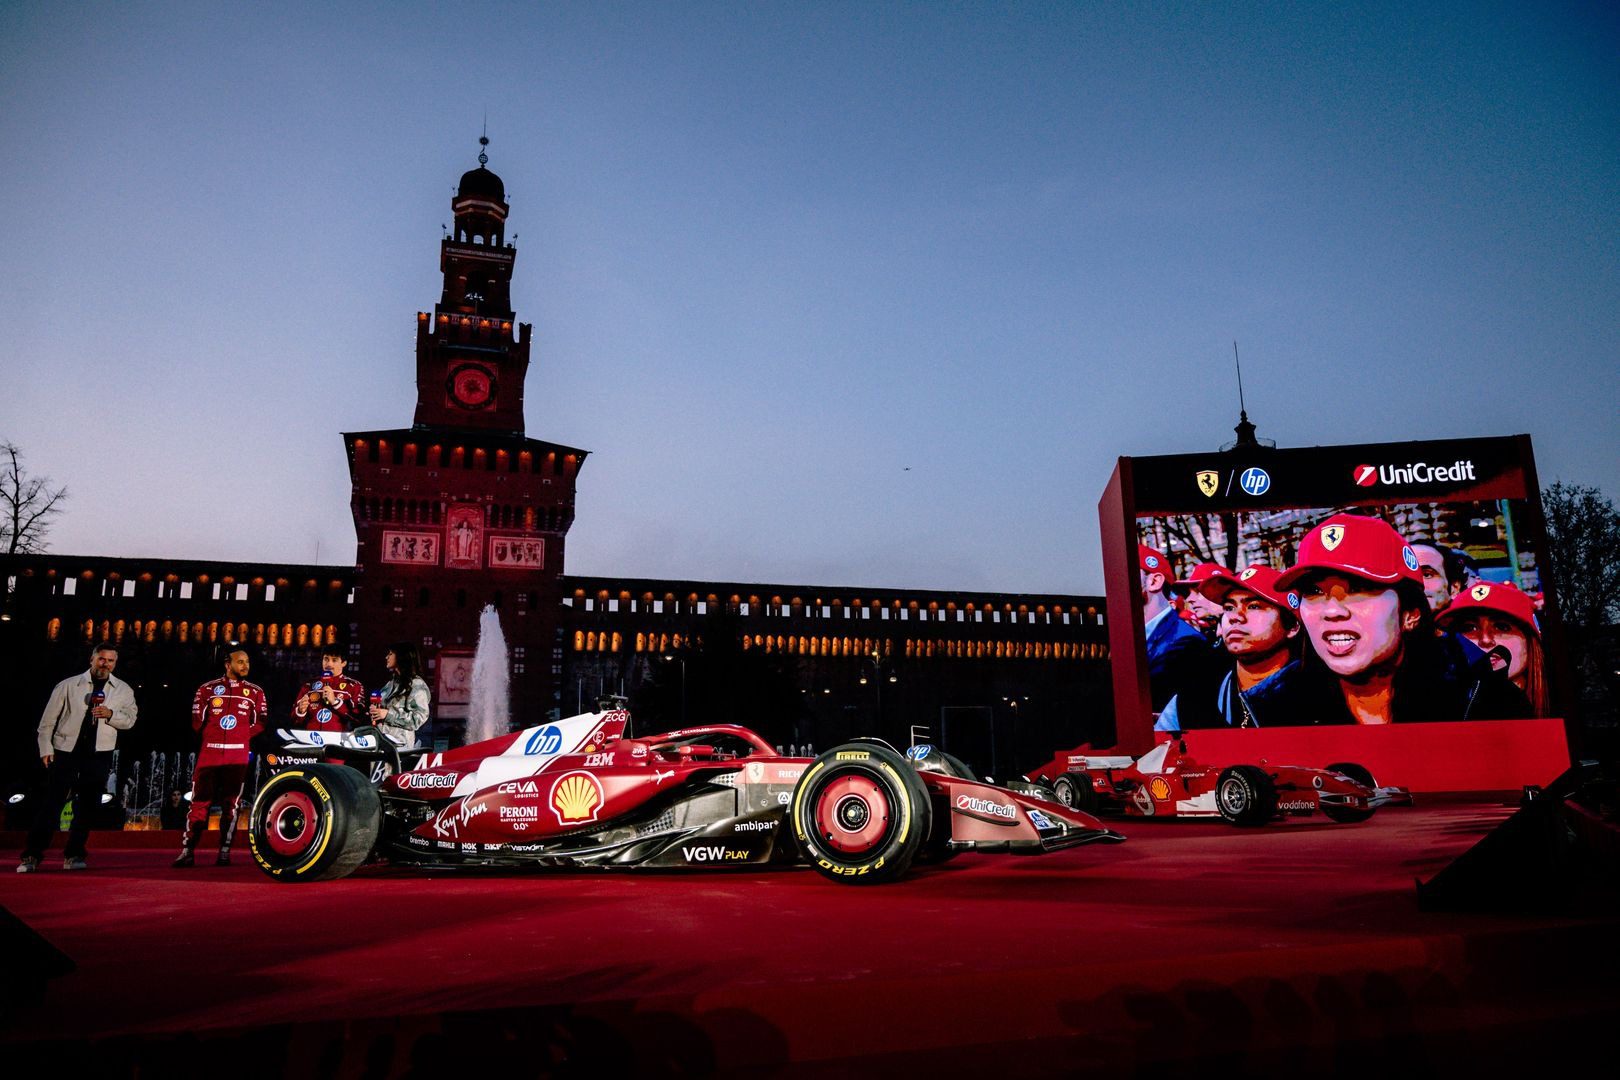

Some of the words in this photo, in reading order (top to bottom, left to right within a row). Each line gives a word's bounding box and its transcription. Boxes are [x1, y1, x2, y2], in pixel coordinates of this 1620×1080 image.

[1379, 461, 1476, 485] UniCredit
[1245, 467, 1267, 495] hp
[1405, 548, 1417, 570] hp
[221, 715, 236, 729] hp
[318, 709, 331, 722] hp
[311, 732, 323, 745] hp
[356, 736, 368, 746] hp
[526, 726, 561, 755] hp
[632, 747, 647, 757] aws
[836, 752, 870, 761] PIRELLI
[277, 755, 318, 765] V-Power
[584, 752, 615, 766] IBM
[410, 773, 456, 787] UniCredit
[310, 777, 331, 802] PIRELLI
[969, 798, 1016, 818] UniCredit
[1278, 800, 1315, 809] vodafone
[500, 806, 538, 817] PERONI
[734, 821, 774, 832] ambipar
[409, 836, 429, 846] brembo
[437, 841, 455, 849] MAHLE
[682, 846, 725, 861] VGW
[725, 851, 749, 860] PLAY
[818, 859, 870, 875] ZERO
[874, 856, 885, 869] P
